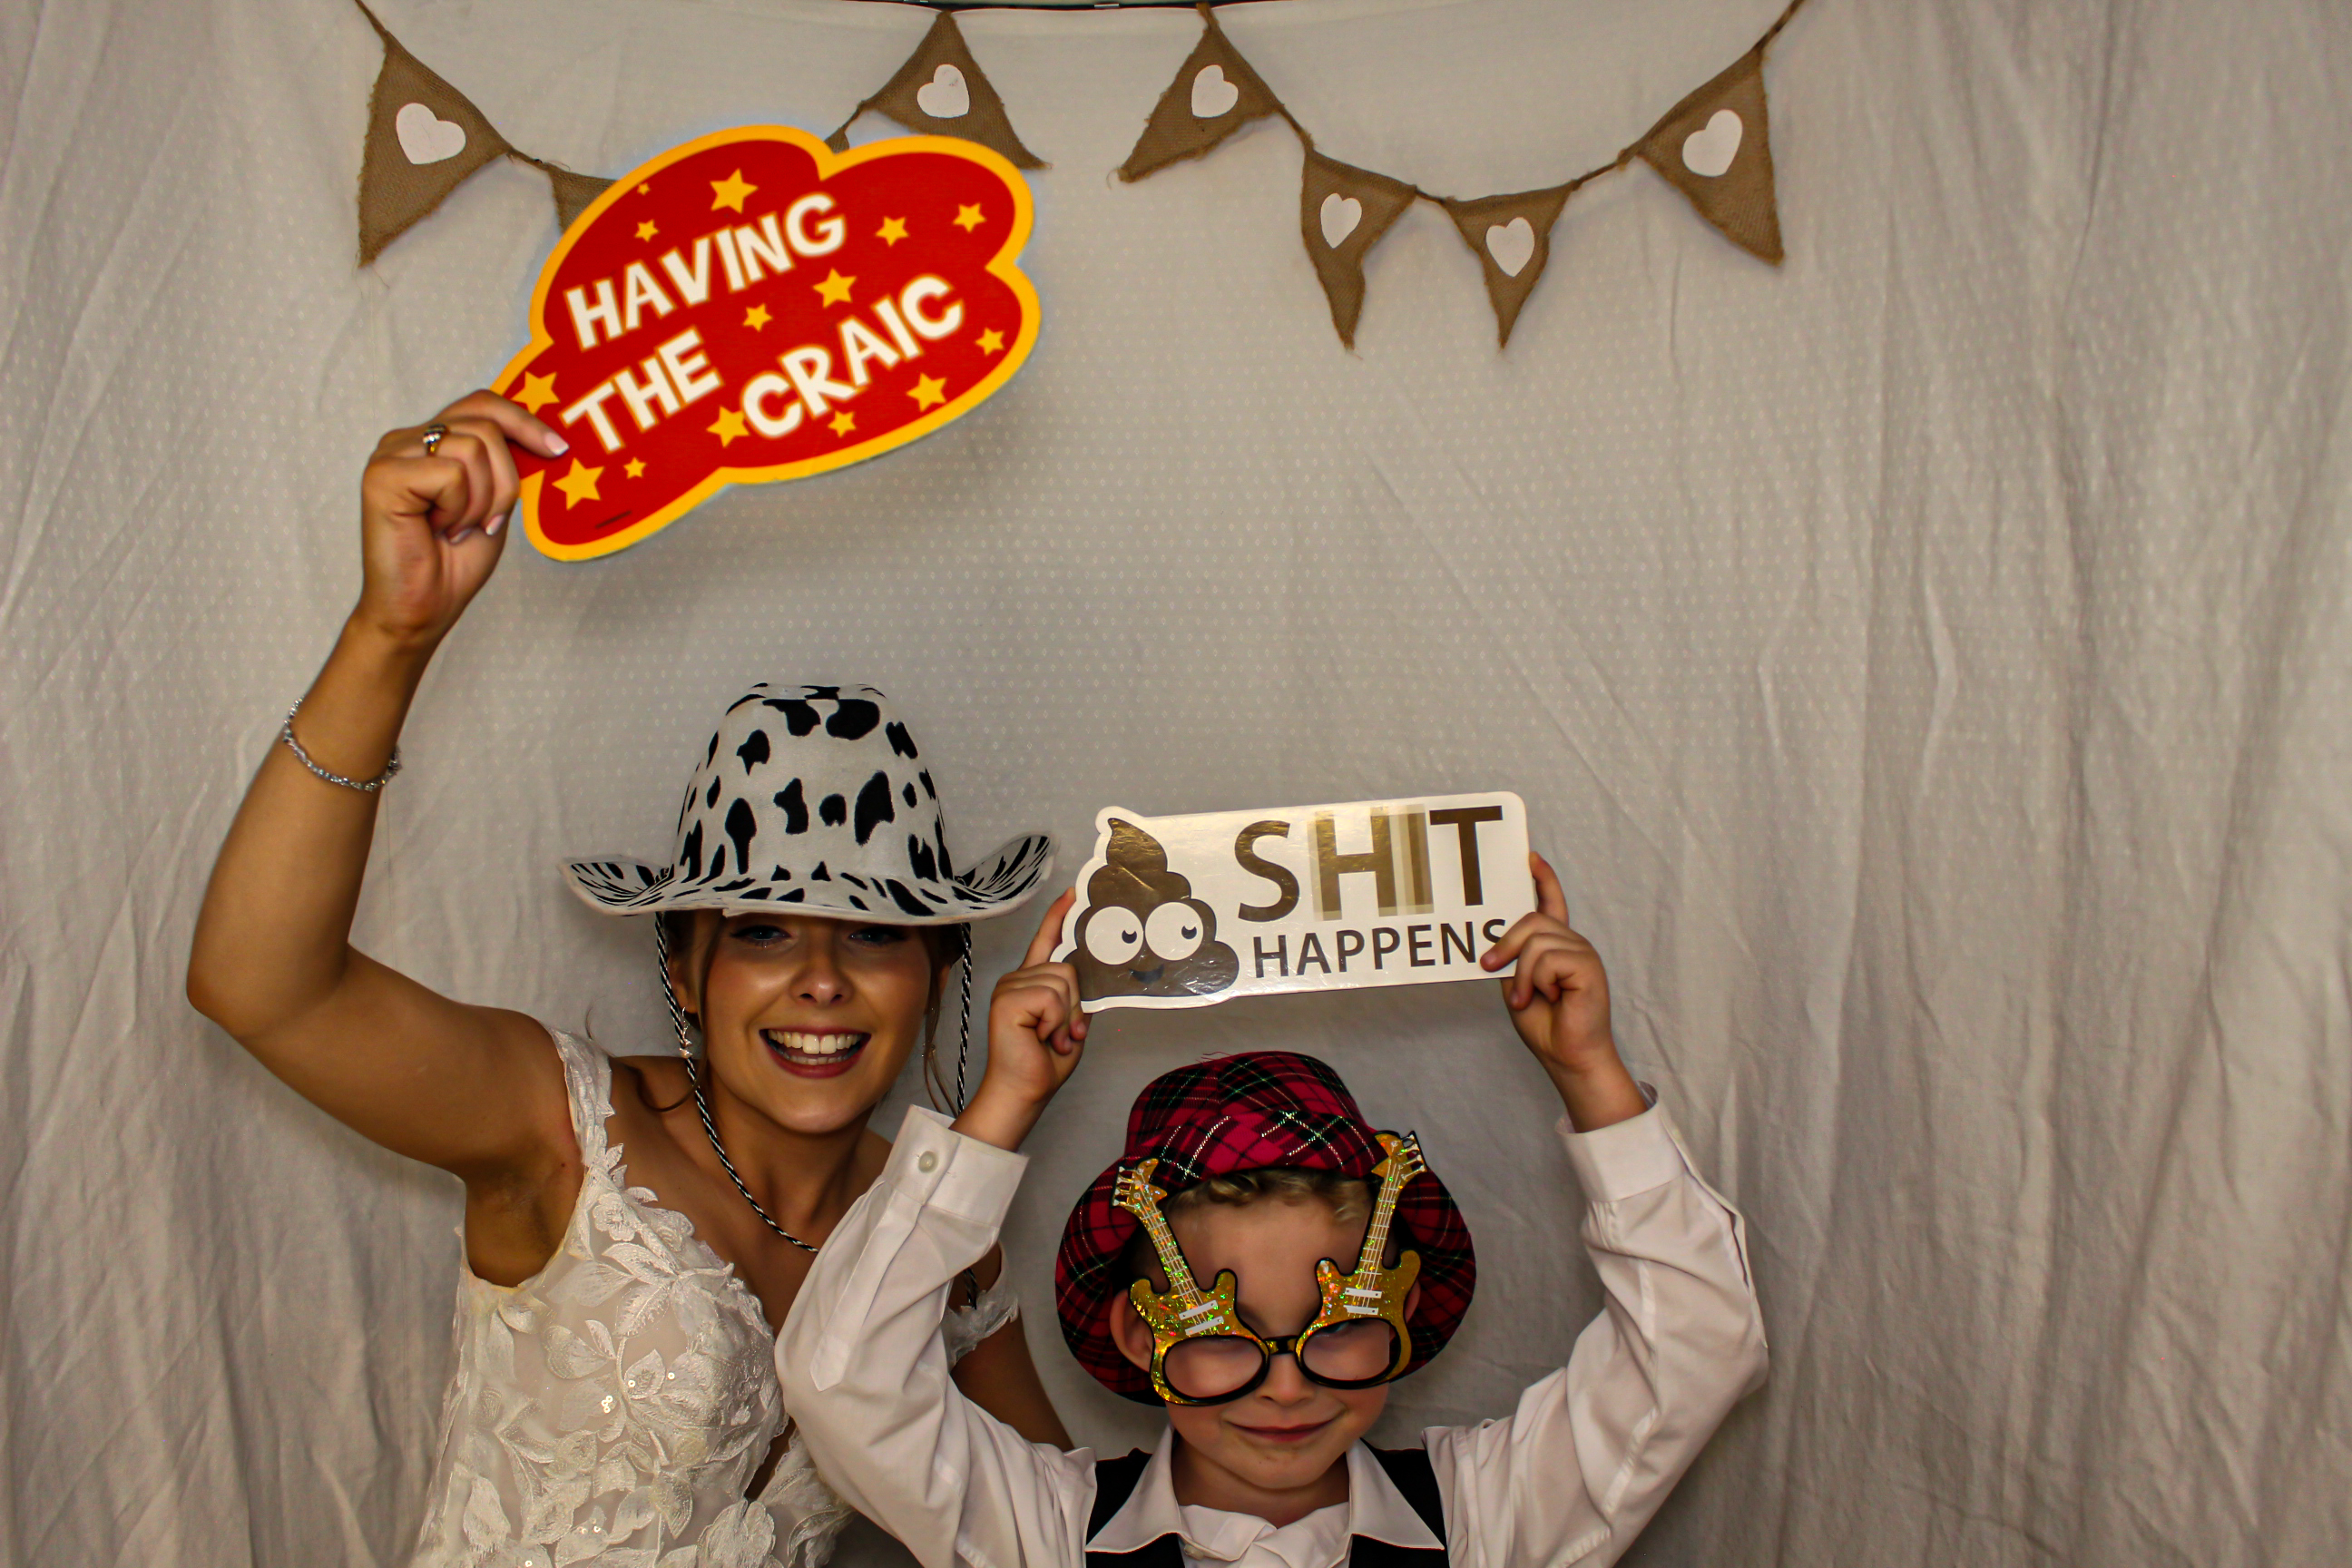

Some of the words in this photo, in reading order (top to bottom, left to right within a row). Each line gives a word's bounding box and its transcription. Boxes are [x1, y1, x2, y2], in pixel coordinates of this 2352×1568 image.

[564, 193, 845, 350] HAVING
[560, 328, 722, 452] THE
[741, 275, 964, 436] CRAIC
[1234, 804, 1503, 922] SHIT
